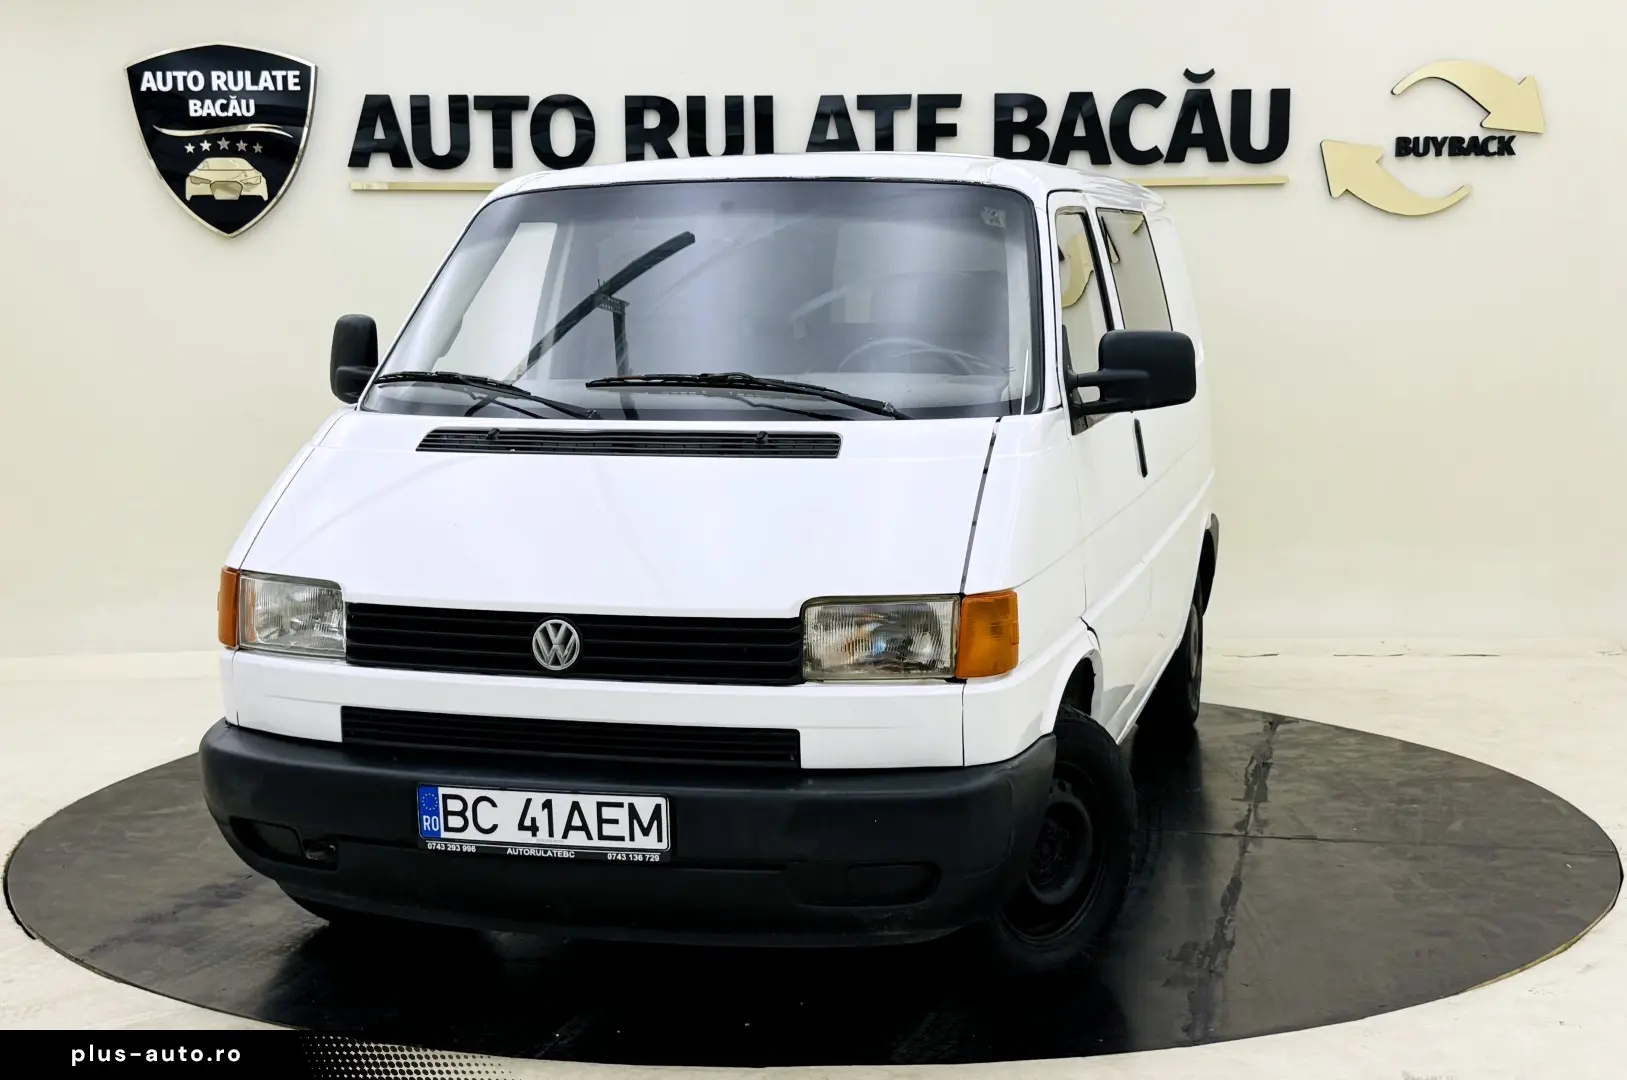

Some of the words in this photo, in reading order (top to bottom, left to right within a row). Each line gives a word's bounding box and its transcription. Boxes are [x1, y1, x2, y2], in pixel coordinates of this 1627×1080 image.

[140, 70, 205, 92] AUTO
[210, 70, 301, 92] RULATE
[188, 95, 256, 117] BACĂU
[348, 93, 596, 170] AUTO
[993, 68, 1291, 165] BACĂU
[1394, 135, 1517, 158] BUYBACK
[422, 815, 440, 832] RO
[441, 793, 499, 835] BC
[517, 797, 663, 843] 41AEM
[427, 842, 446, 851] 0743
[446, 844, 460, 852] 293
[506, 847, 575, 859] AUTORULATEBC
[607, 853, 626, 861] 0743
[645, 854, 660, 862] 729
